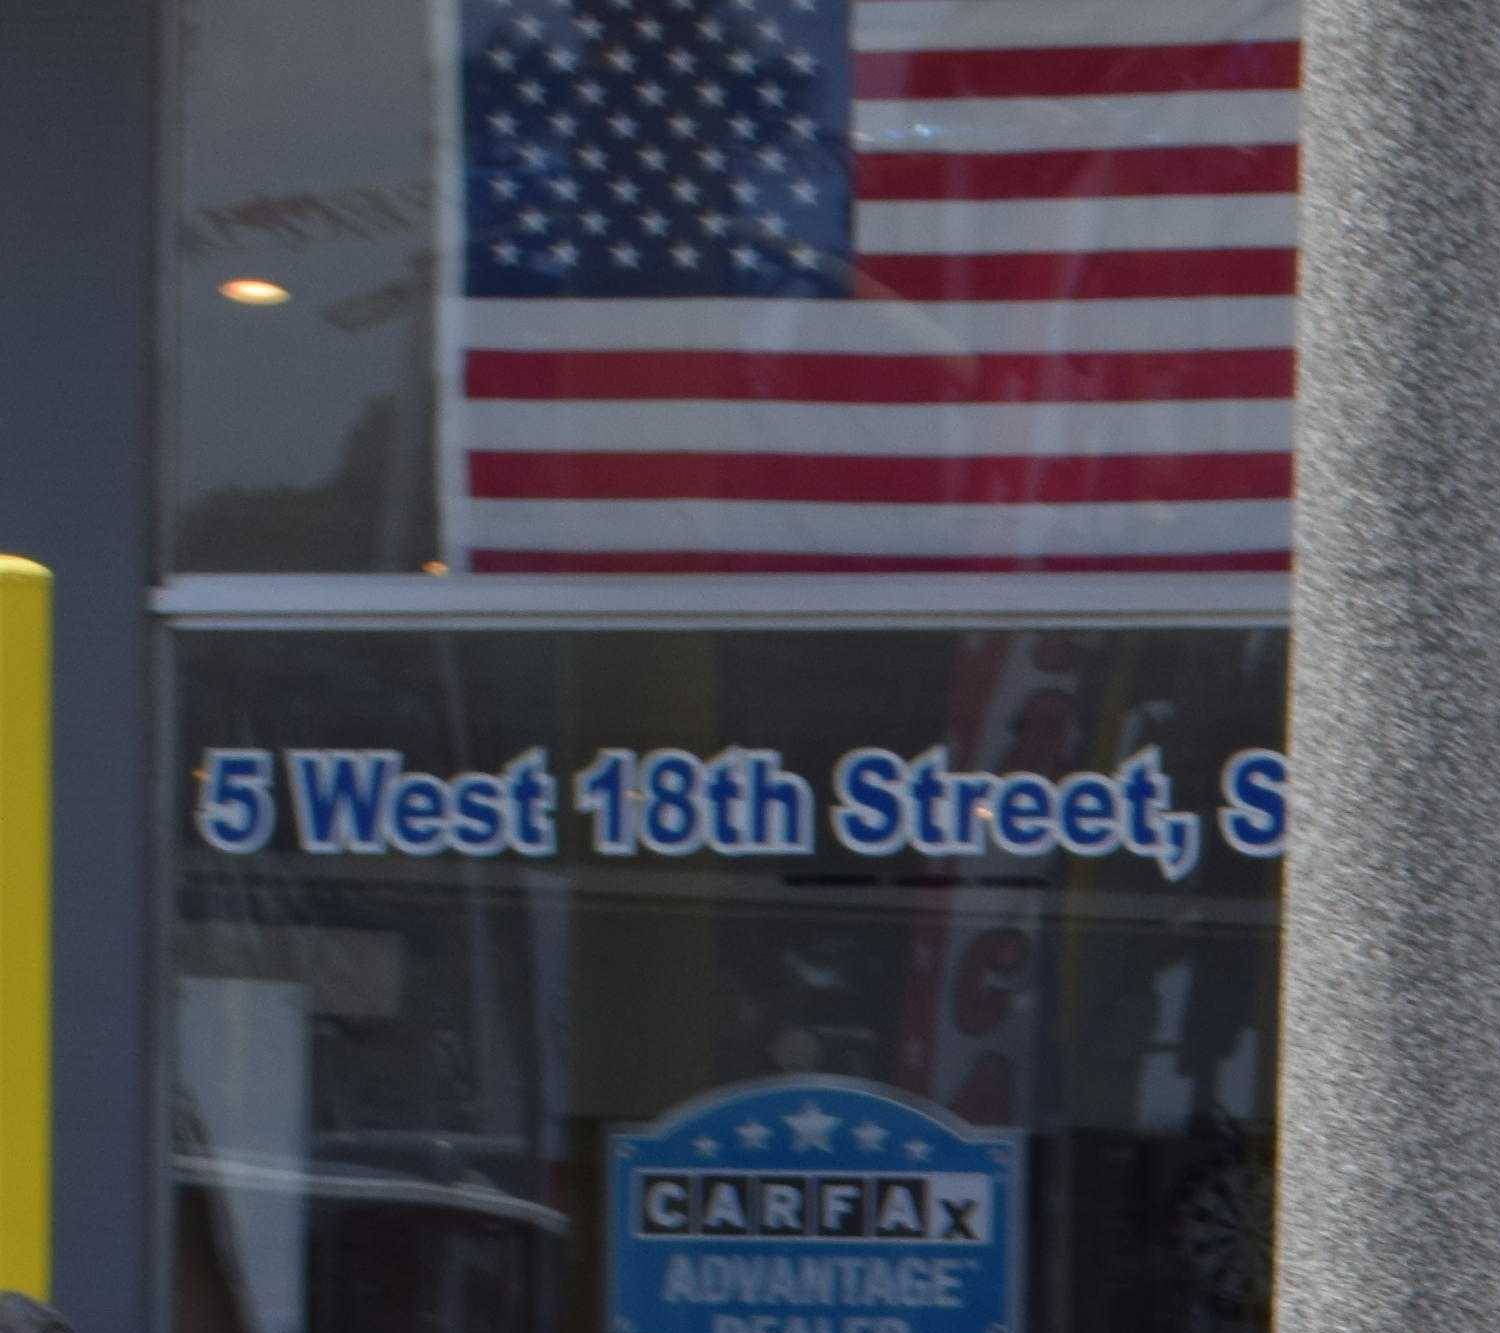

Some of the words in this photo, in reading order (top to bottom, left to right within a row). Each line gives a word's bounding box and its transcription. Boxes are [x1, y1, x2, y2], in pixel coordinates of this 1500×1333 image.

[200, 747, 275, 855] 5
[283, 745, 557, 855] West
[575, 745, 814, 856] 18th
[831, 745, 1197, 882] Street,
[645, 1181, 980, 1239] CARFAX
[663, 1254, 964, 1308] ADVANTAGE
